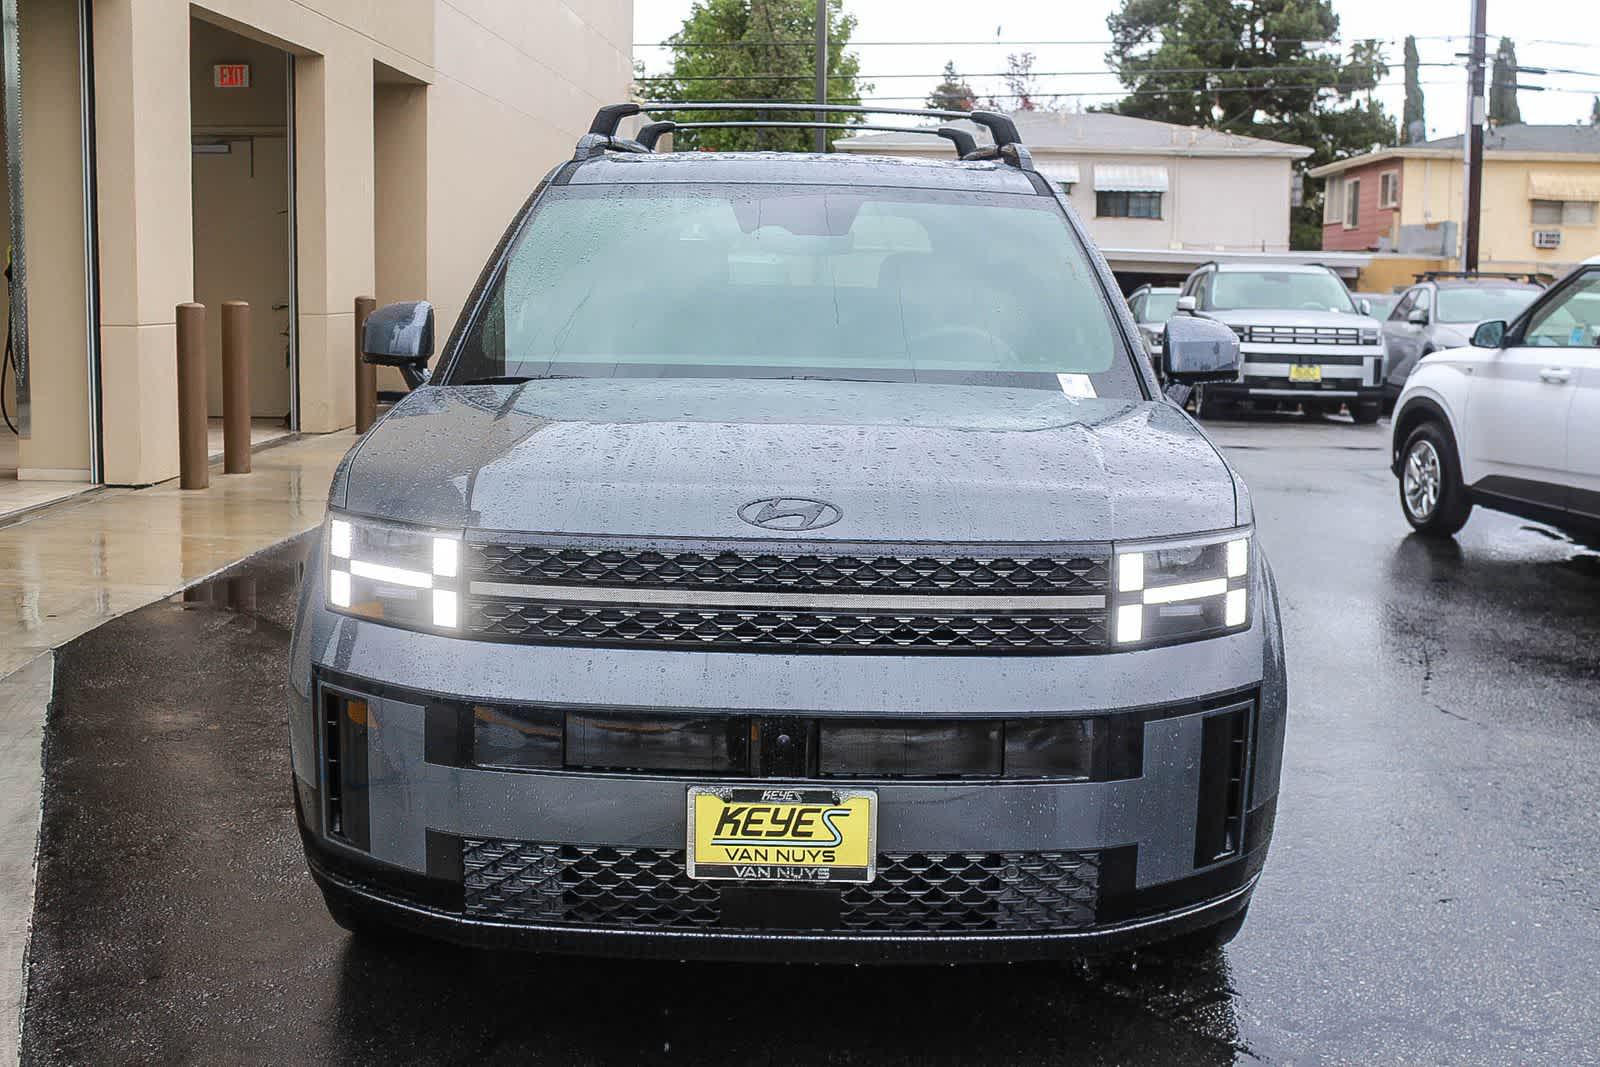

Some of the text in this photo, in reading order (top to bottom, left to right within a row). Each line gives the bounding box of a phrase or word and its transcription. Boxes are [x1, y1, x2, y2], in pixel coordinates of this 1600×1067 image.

[220, 66, 244, 86] EXIT
[713, 807, 852, 844] KEYES
[724, 848, 835, 862] VAN NUYS
[733, 866, 830, 880] VAN NUYS
